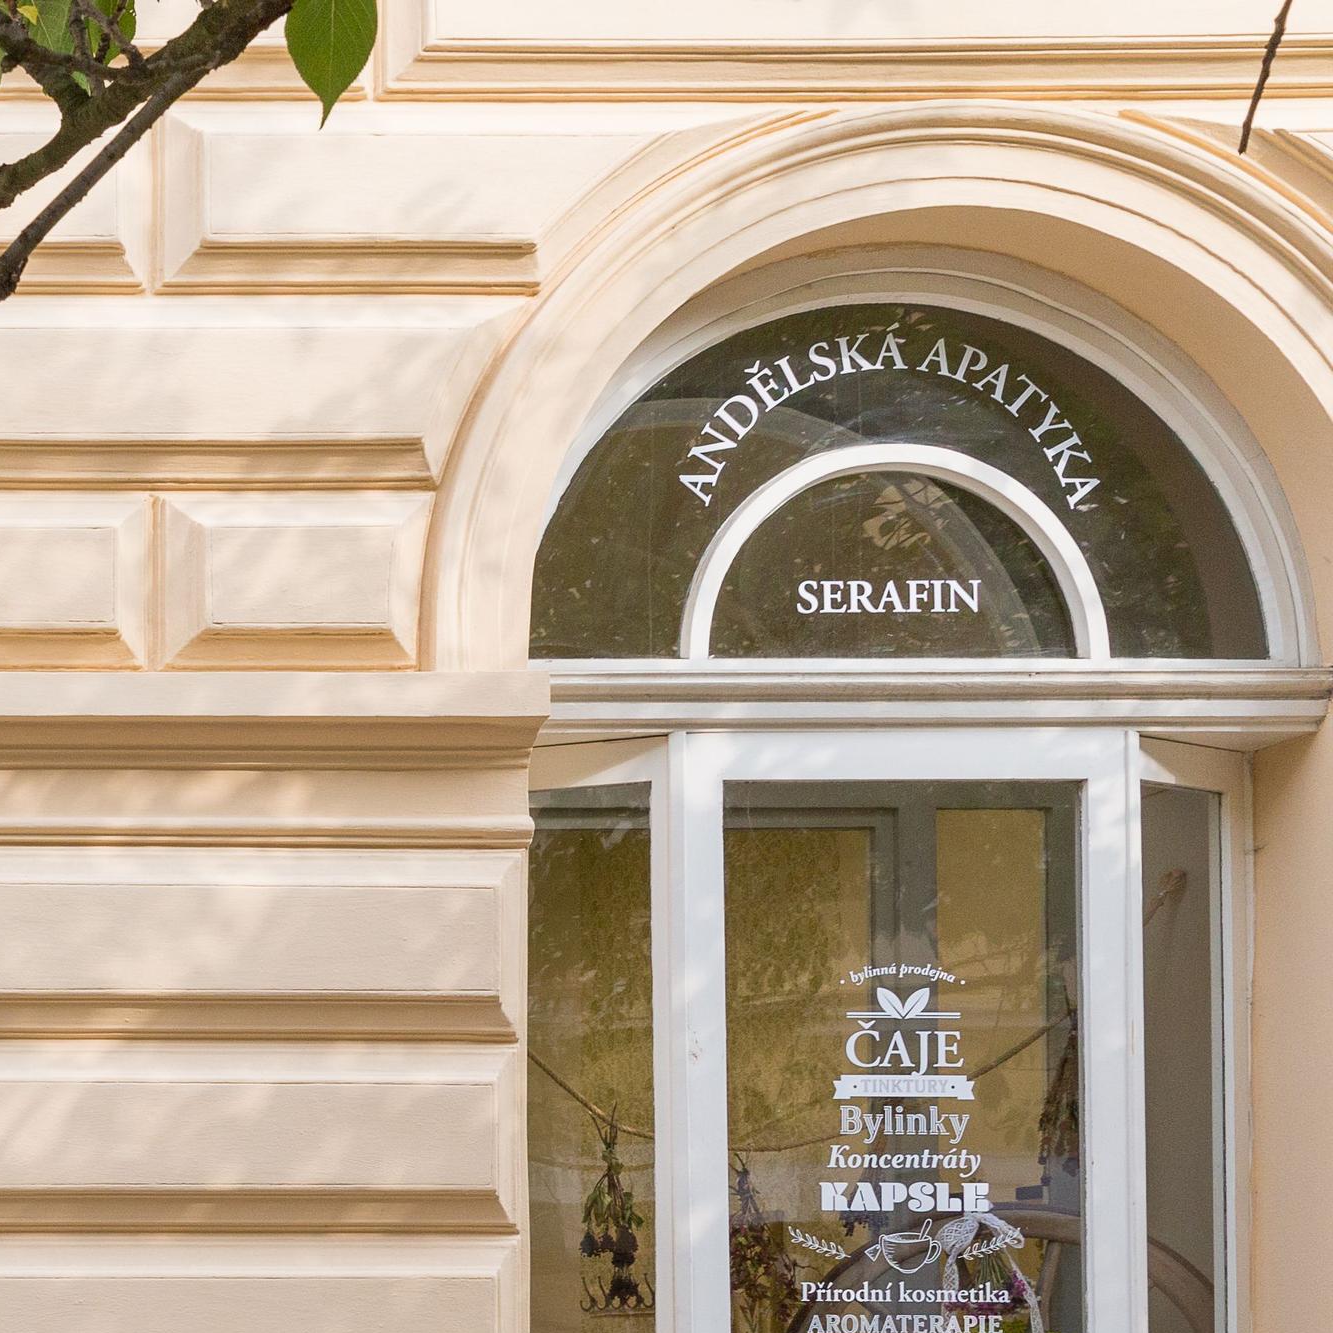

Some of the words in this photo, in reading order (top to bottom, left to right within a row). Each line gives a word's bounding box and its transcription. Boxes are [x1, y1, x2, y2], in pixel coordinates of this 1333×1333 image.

[677, 322, 909, 507] ANDĚLSKÁ
[915, 337, 1102, 510] APATYKA
[796, 579, 982, 614] SERAFIN
[849, 963, 896, 985] bylinná
[899, 963, 956, 983] prodejna
[845, 1020, 965, 1077] ČAJE
[860, 1079, 949, 1094] TINKTURY
[839, 1105, 970, 1144] Bylinky
[827, 1144, 982, 1178] Koncentráty
[819, 1182, 991, 1212] KAPSLE
[800, 1281, 893, 1303] Přírodní
[899, 1281, 1011, 1303] kosmetika
